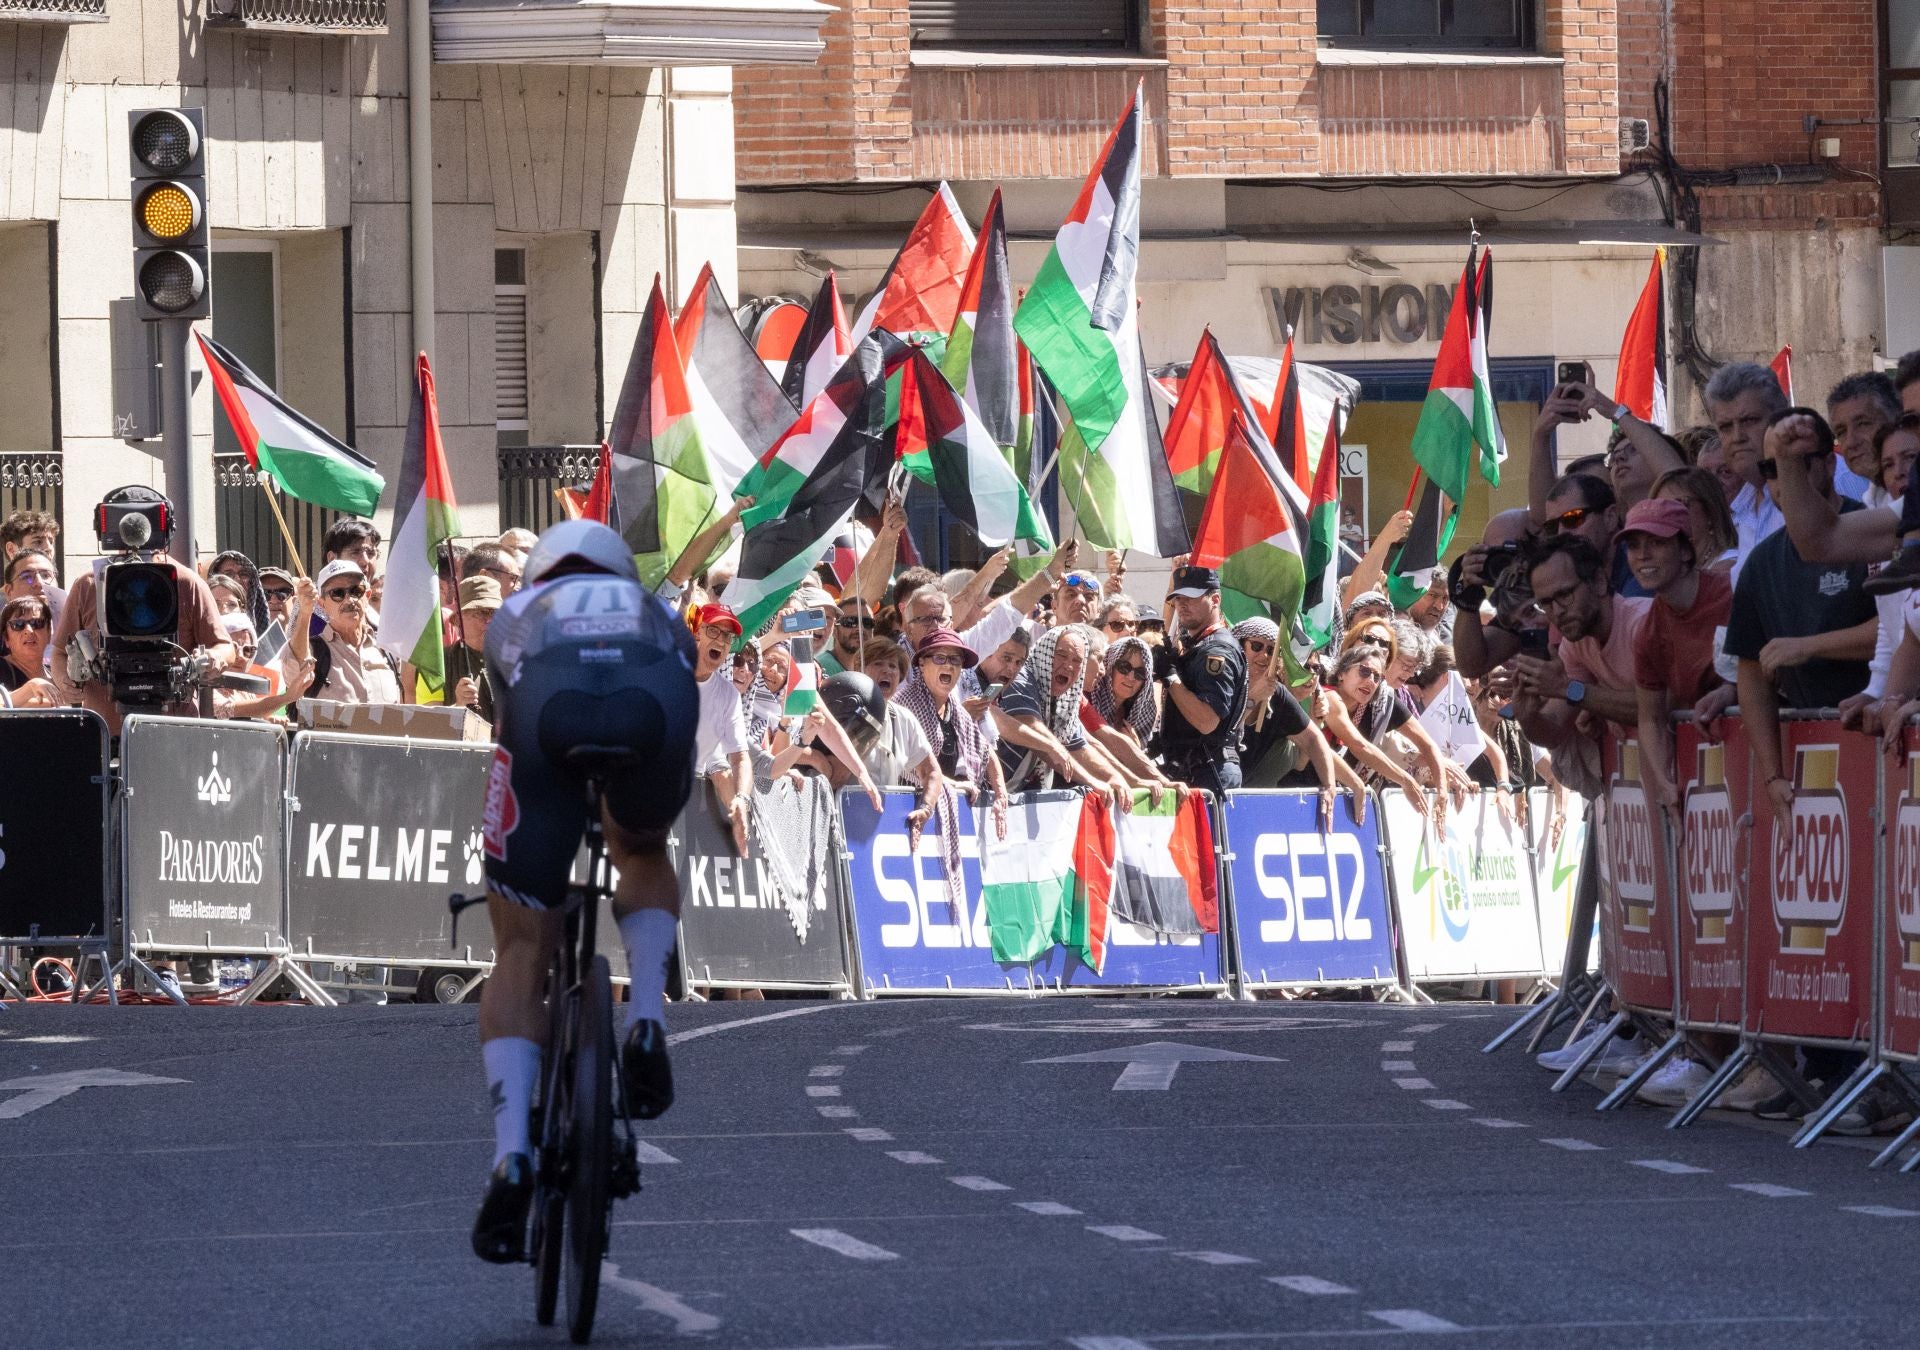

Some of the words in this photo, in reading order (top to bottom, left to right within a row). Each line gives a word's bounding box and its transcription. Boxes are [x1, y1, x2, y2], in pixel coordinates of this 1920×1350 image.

[306, 823, 453, 884] KELME
[1468, 844, 1517, 881] Asturias
[688, 855, 781, 910] KELM
[169, 899, 193, 919] Hoteles
[198, 901, 238, 920] Restaurantes
